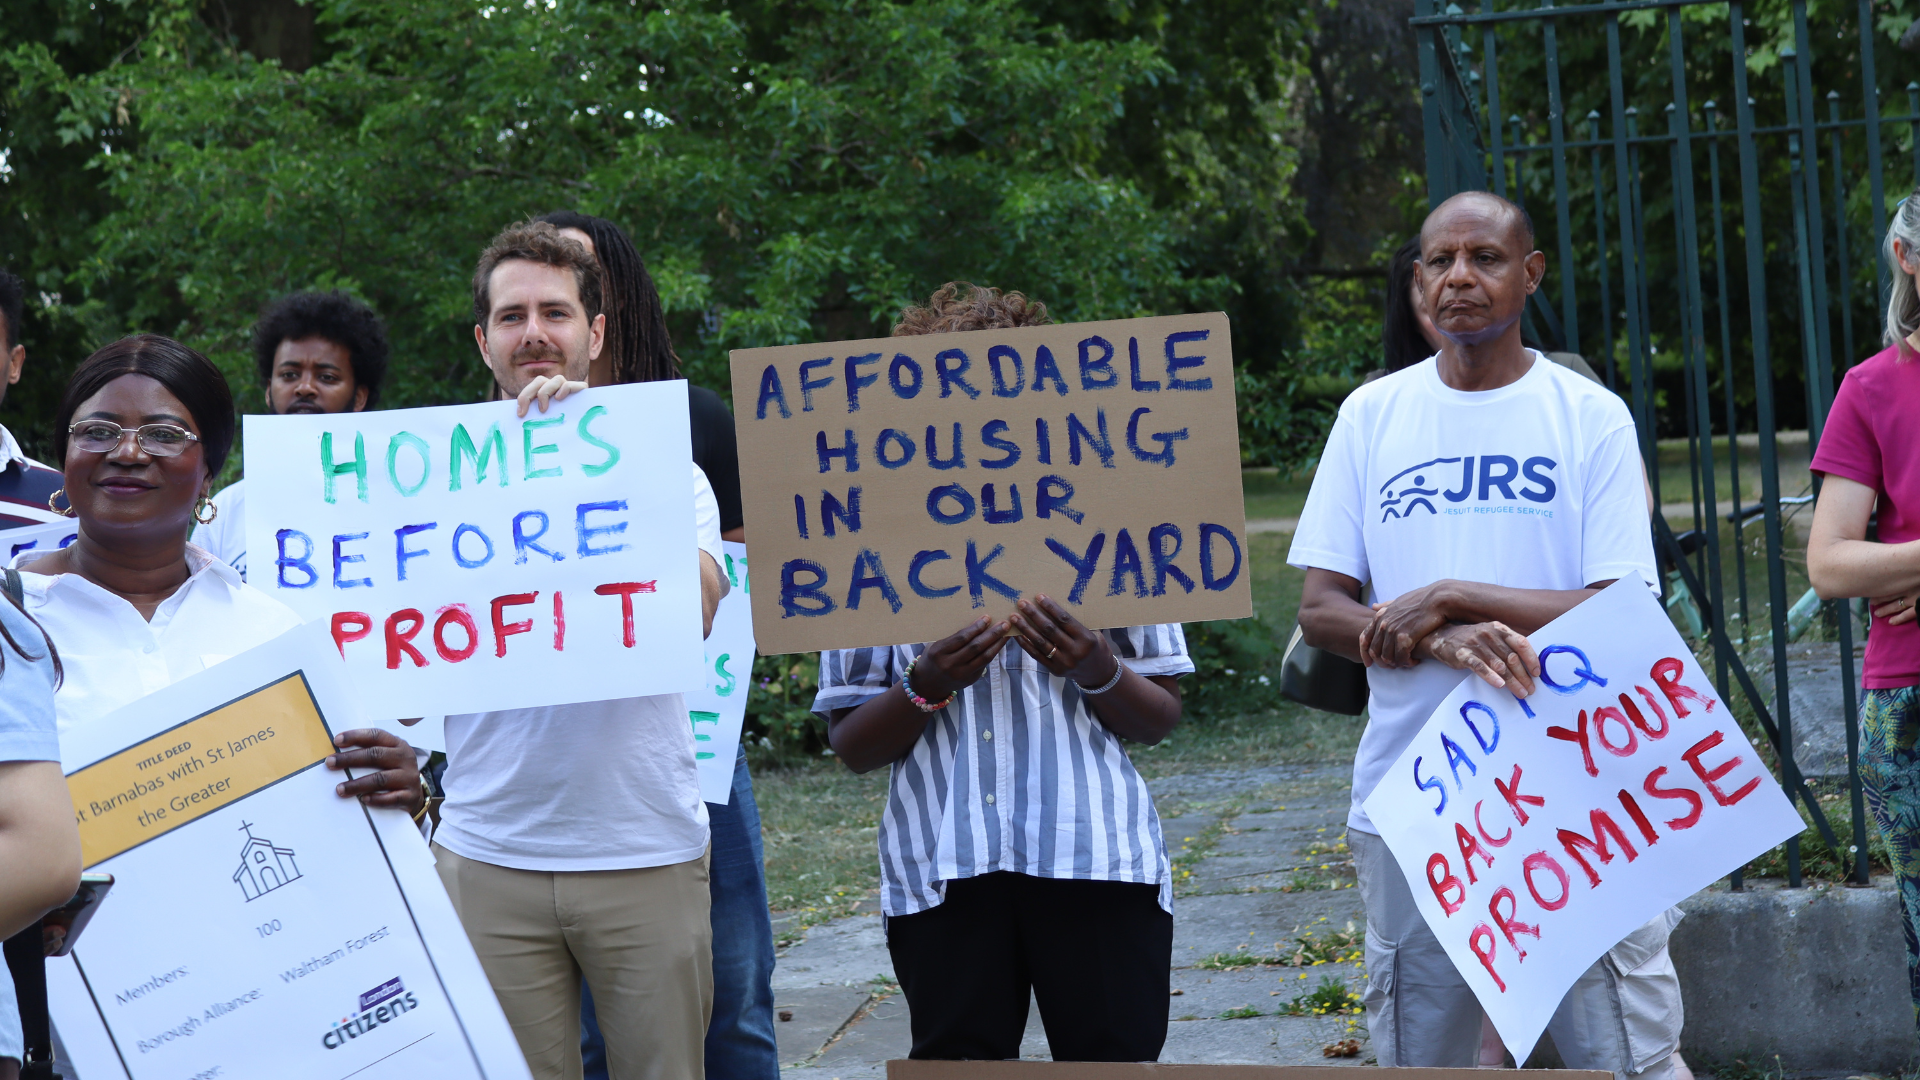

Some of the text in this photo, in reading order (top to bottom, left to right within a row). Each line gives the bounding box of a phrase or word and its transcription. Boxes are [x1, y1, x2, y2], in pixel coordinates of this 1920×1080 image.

[756, 329, 1212, 420] AFFORDABLE
[320, 405, 620, 503] HOMES
[816, 406, 1189, 473] HOUSING
[794, 474, 1085, 539] IN OUR
[1443, 455, 1557, 503] JRS
[1443, 505, 1554, 518] JESUIT REFUGEE SERVICE
[275, 499, 632, 589] BEFORE
[779, 538, 1023, 619] BACK
[1045, 522, 1242, 605] YARD
[330, 579, 657, 670] PROFIT
[90, 774, 165, 817] Barnabas
[167, 756, 205, 782] with
[206, 746, 225, 764] St
[226, 726, 275, 757] James
[136, 741, 192, 771] TITLE DEED
[1426, 656, 1717, 918] BACK YOUR
[137, 777, 231, 828] the Greater
[1470, 730, 1762, 993] PROMISE
[255, 918, 283, 939] 100
[114, 965, 191, 1007] Members:
[136, 925, 391, 1054] Borough Alliance: Waltham Forest
[322, 991, 419, 1049] citizens
